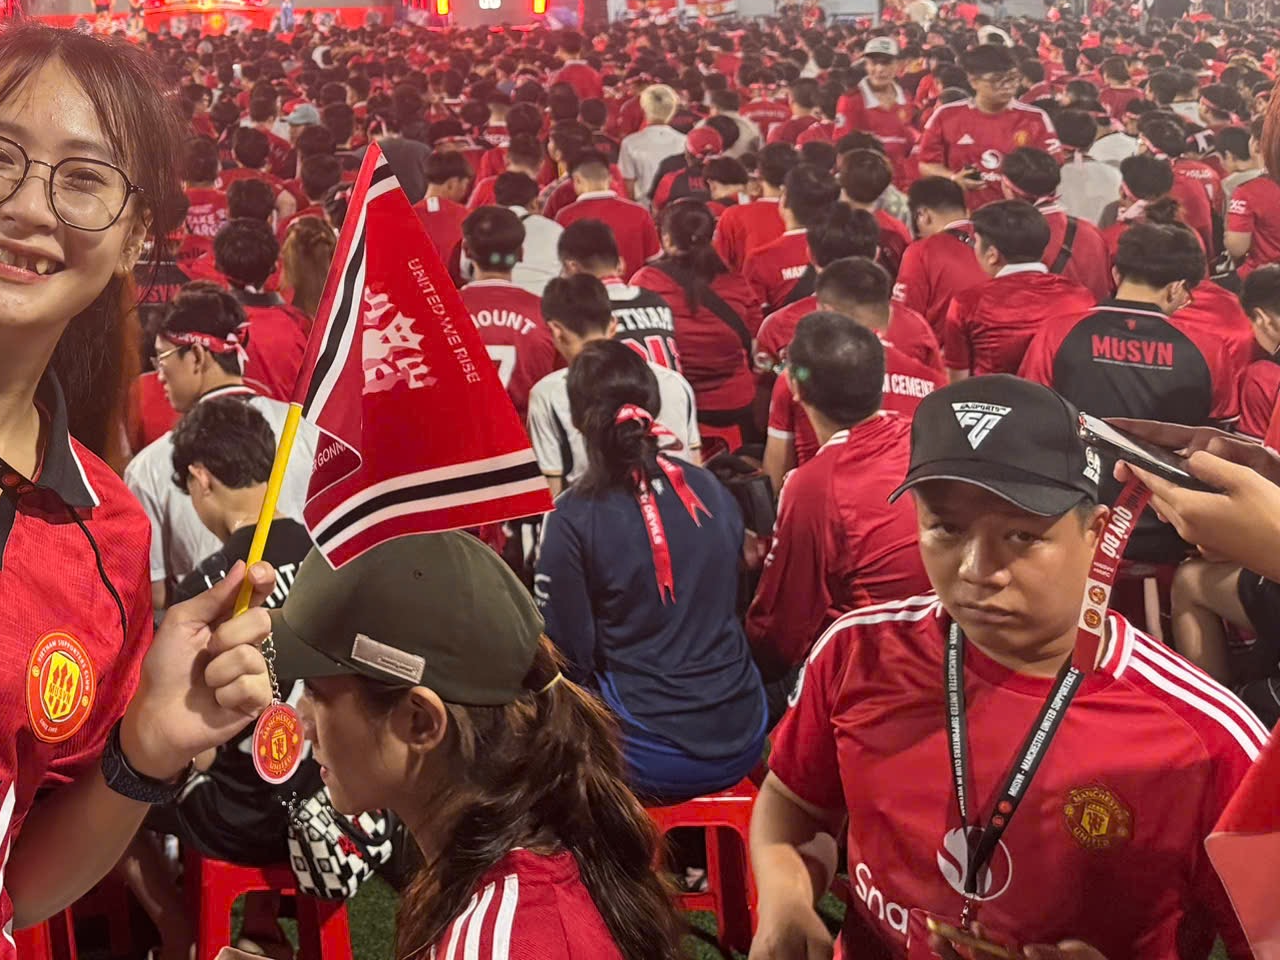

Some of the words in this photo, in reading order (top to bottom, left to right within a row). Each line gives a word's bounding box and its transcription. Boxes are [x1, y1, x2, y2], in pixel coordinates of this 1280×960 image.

[408, 257, 445, 317] UNITED
[441, 315, 459, 347] WE
[453, 347, 480, 385] RISE
[612, 306, 674, 332] ETNAM
[1092, 334, 1175, 366] MUSVN
[487, 345, 516, 390] 7
[891, 373, 935, 398] CEMENT
[643, 504, 663, 545] DEVILS
[1100, 533, 1121, 560] ĐỎ
[38, 640, 57, 662] VIETNAM
[58, 639, 87, 669] SUPPORTERS
[948, 649, 959, 692] MANCHESTER
[949, 692, 959, 716] UNITED
[262, 712, 296, 740] MANCHESTER
[951, 716, 962, 759] SUPPORTERS
[1008, 773, 1025, 798] MUSVN
[1020, 730, 1048, 772] MANCHESTER
[1040, 709, 1058, 732] UNITED
[1053, 671, 1077, 711] SUPPORTERS
[954, 760, 962, 775] CLUB
